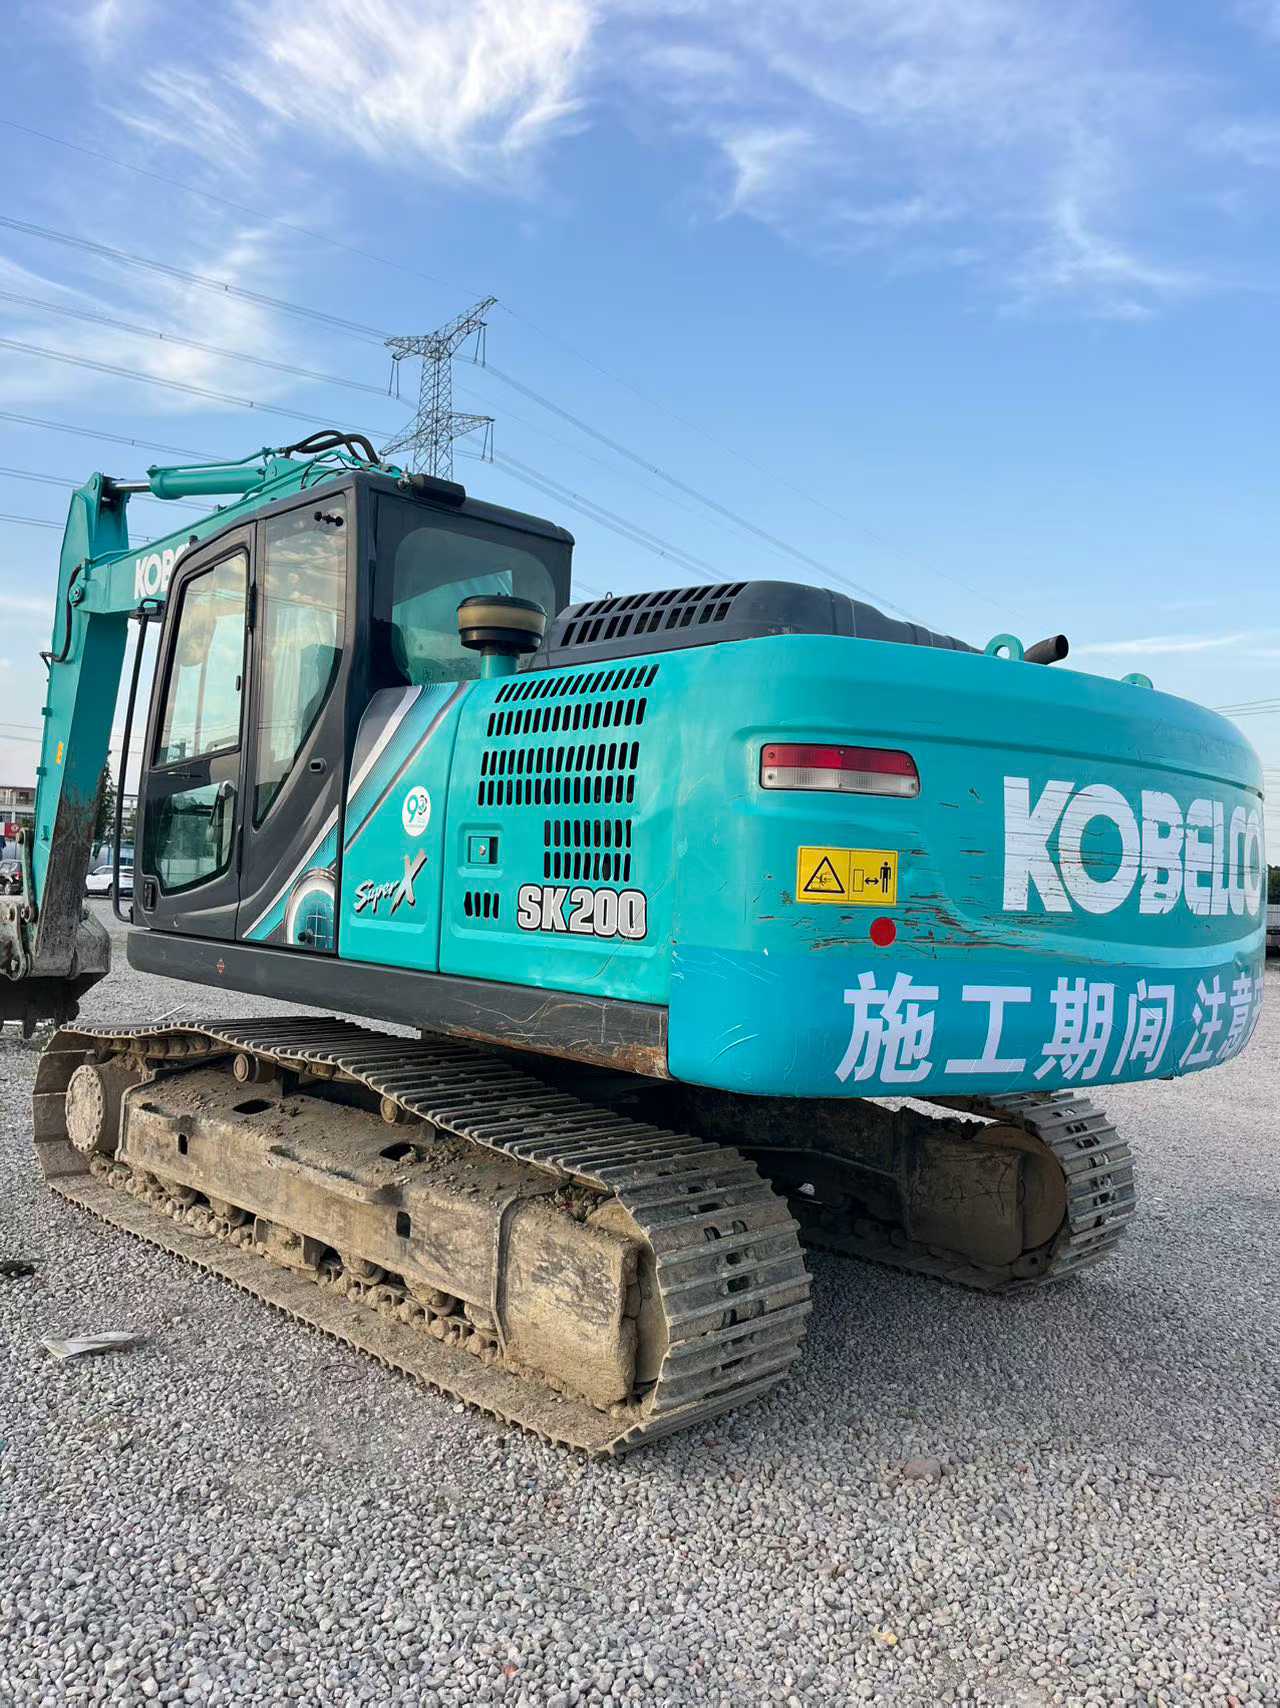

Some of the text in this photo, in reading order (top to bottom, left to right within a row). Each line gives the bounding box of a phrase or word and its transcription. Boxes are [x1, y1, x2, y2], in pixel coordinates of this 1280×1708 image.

[134, 543, 191, 600] KOB
[1002, 776, 1262, 916] KOBELCO
[517, 884, 647, 940] SK200
